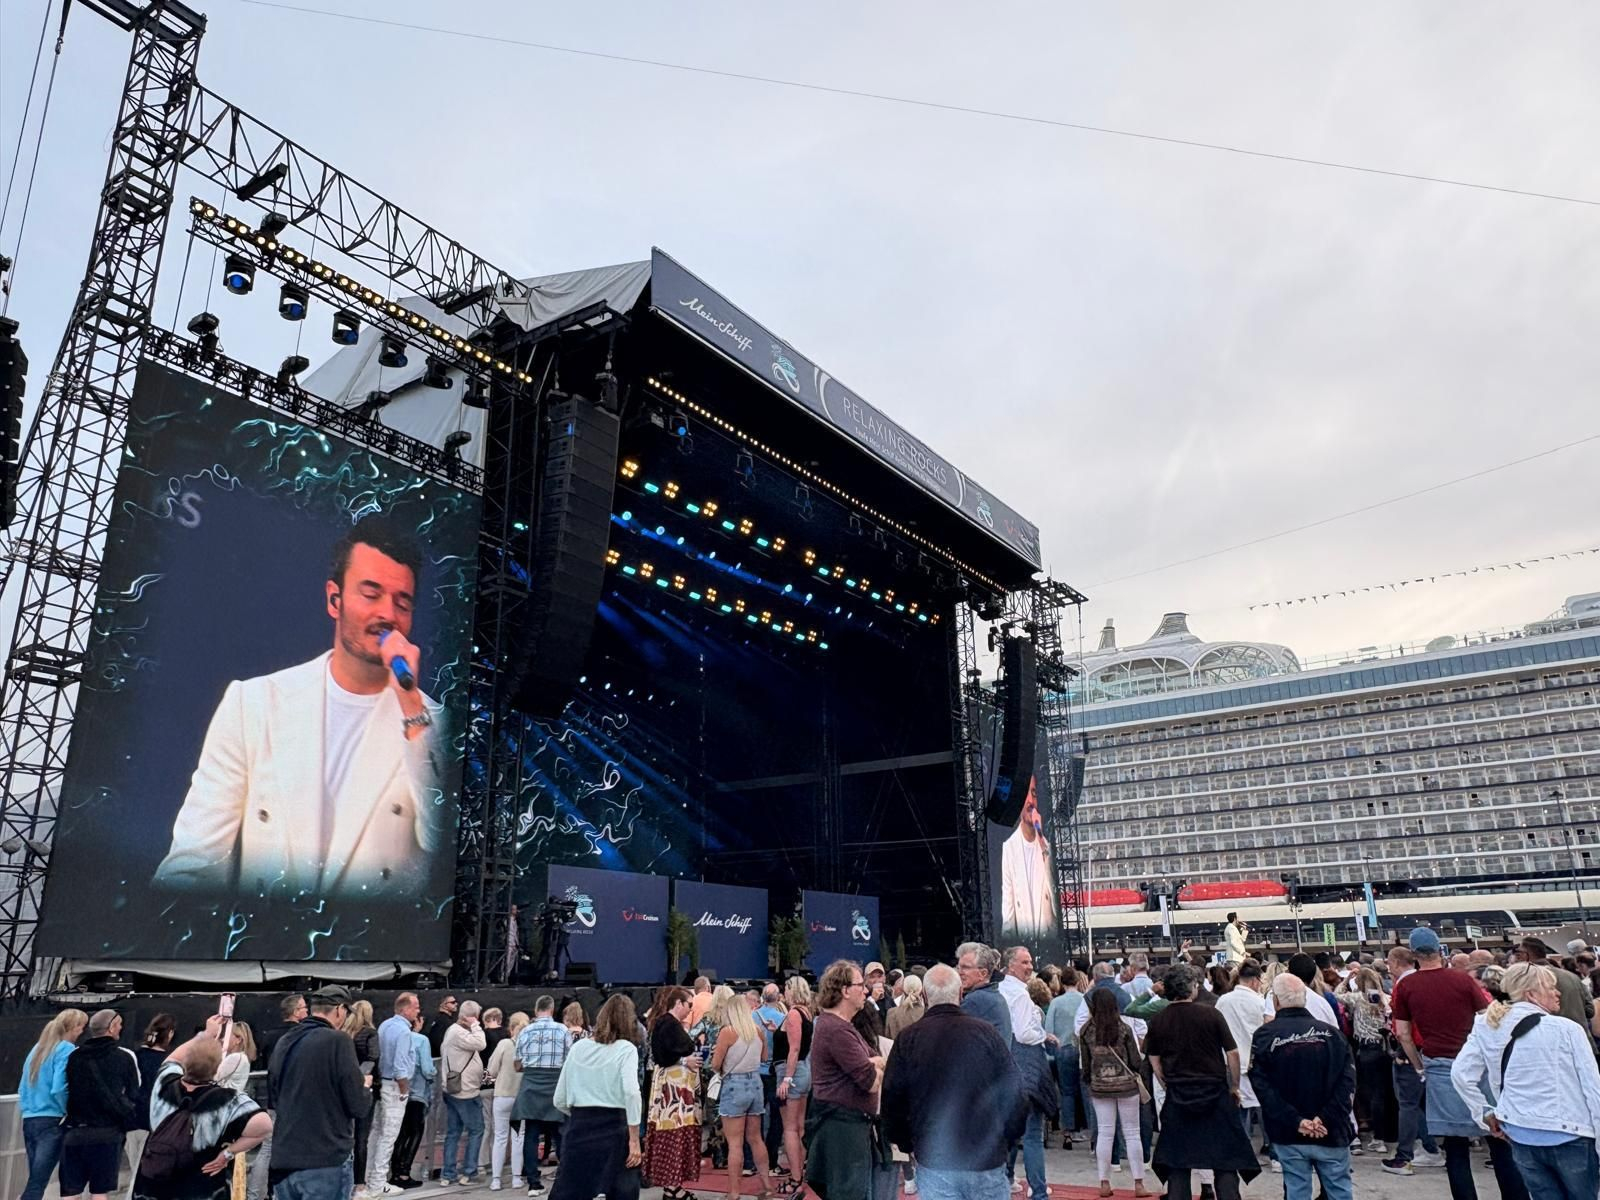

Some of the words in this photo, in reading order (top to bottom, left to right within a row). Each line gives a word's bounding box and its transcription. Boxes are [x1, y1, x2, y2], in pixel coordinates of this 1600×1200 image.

[679, 298, 719, 327] Mein
[718, 322, 753, 351] Schiff
[843, 396, 905, 455] RELAXING
[910, 445, 947, 485] ROCKS
[692, 911, 723, 926] Mein
[724, 913, 752, 934] Schiff
